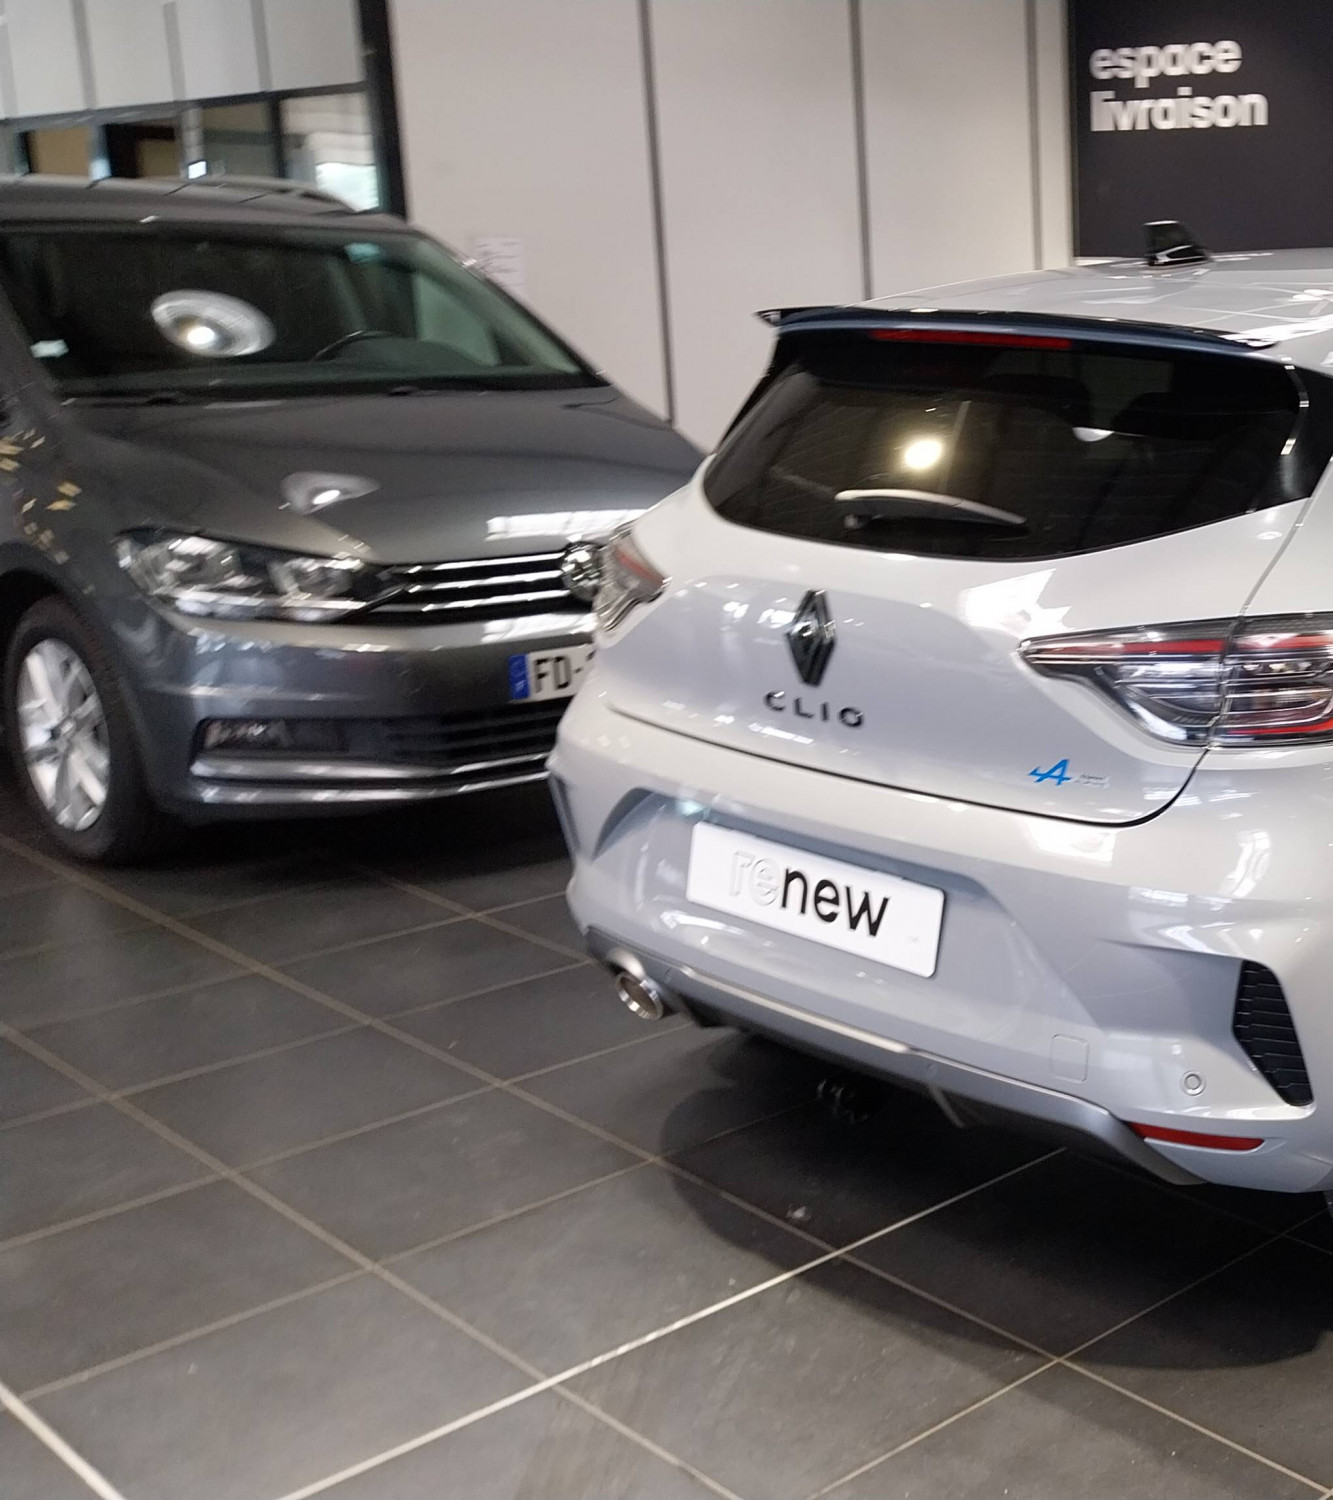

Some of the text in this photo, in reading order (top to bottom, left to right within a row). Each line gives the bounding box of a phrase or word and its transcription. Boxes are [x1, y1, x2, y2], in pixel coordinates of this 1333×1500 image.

[1090, 40, 1242, 88] espace
[1090, 86, 1268, 131] livraison
[763, 690, 865, 728] CLIO
